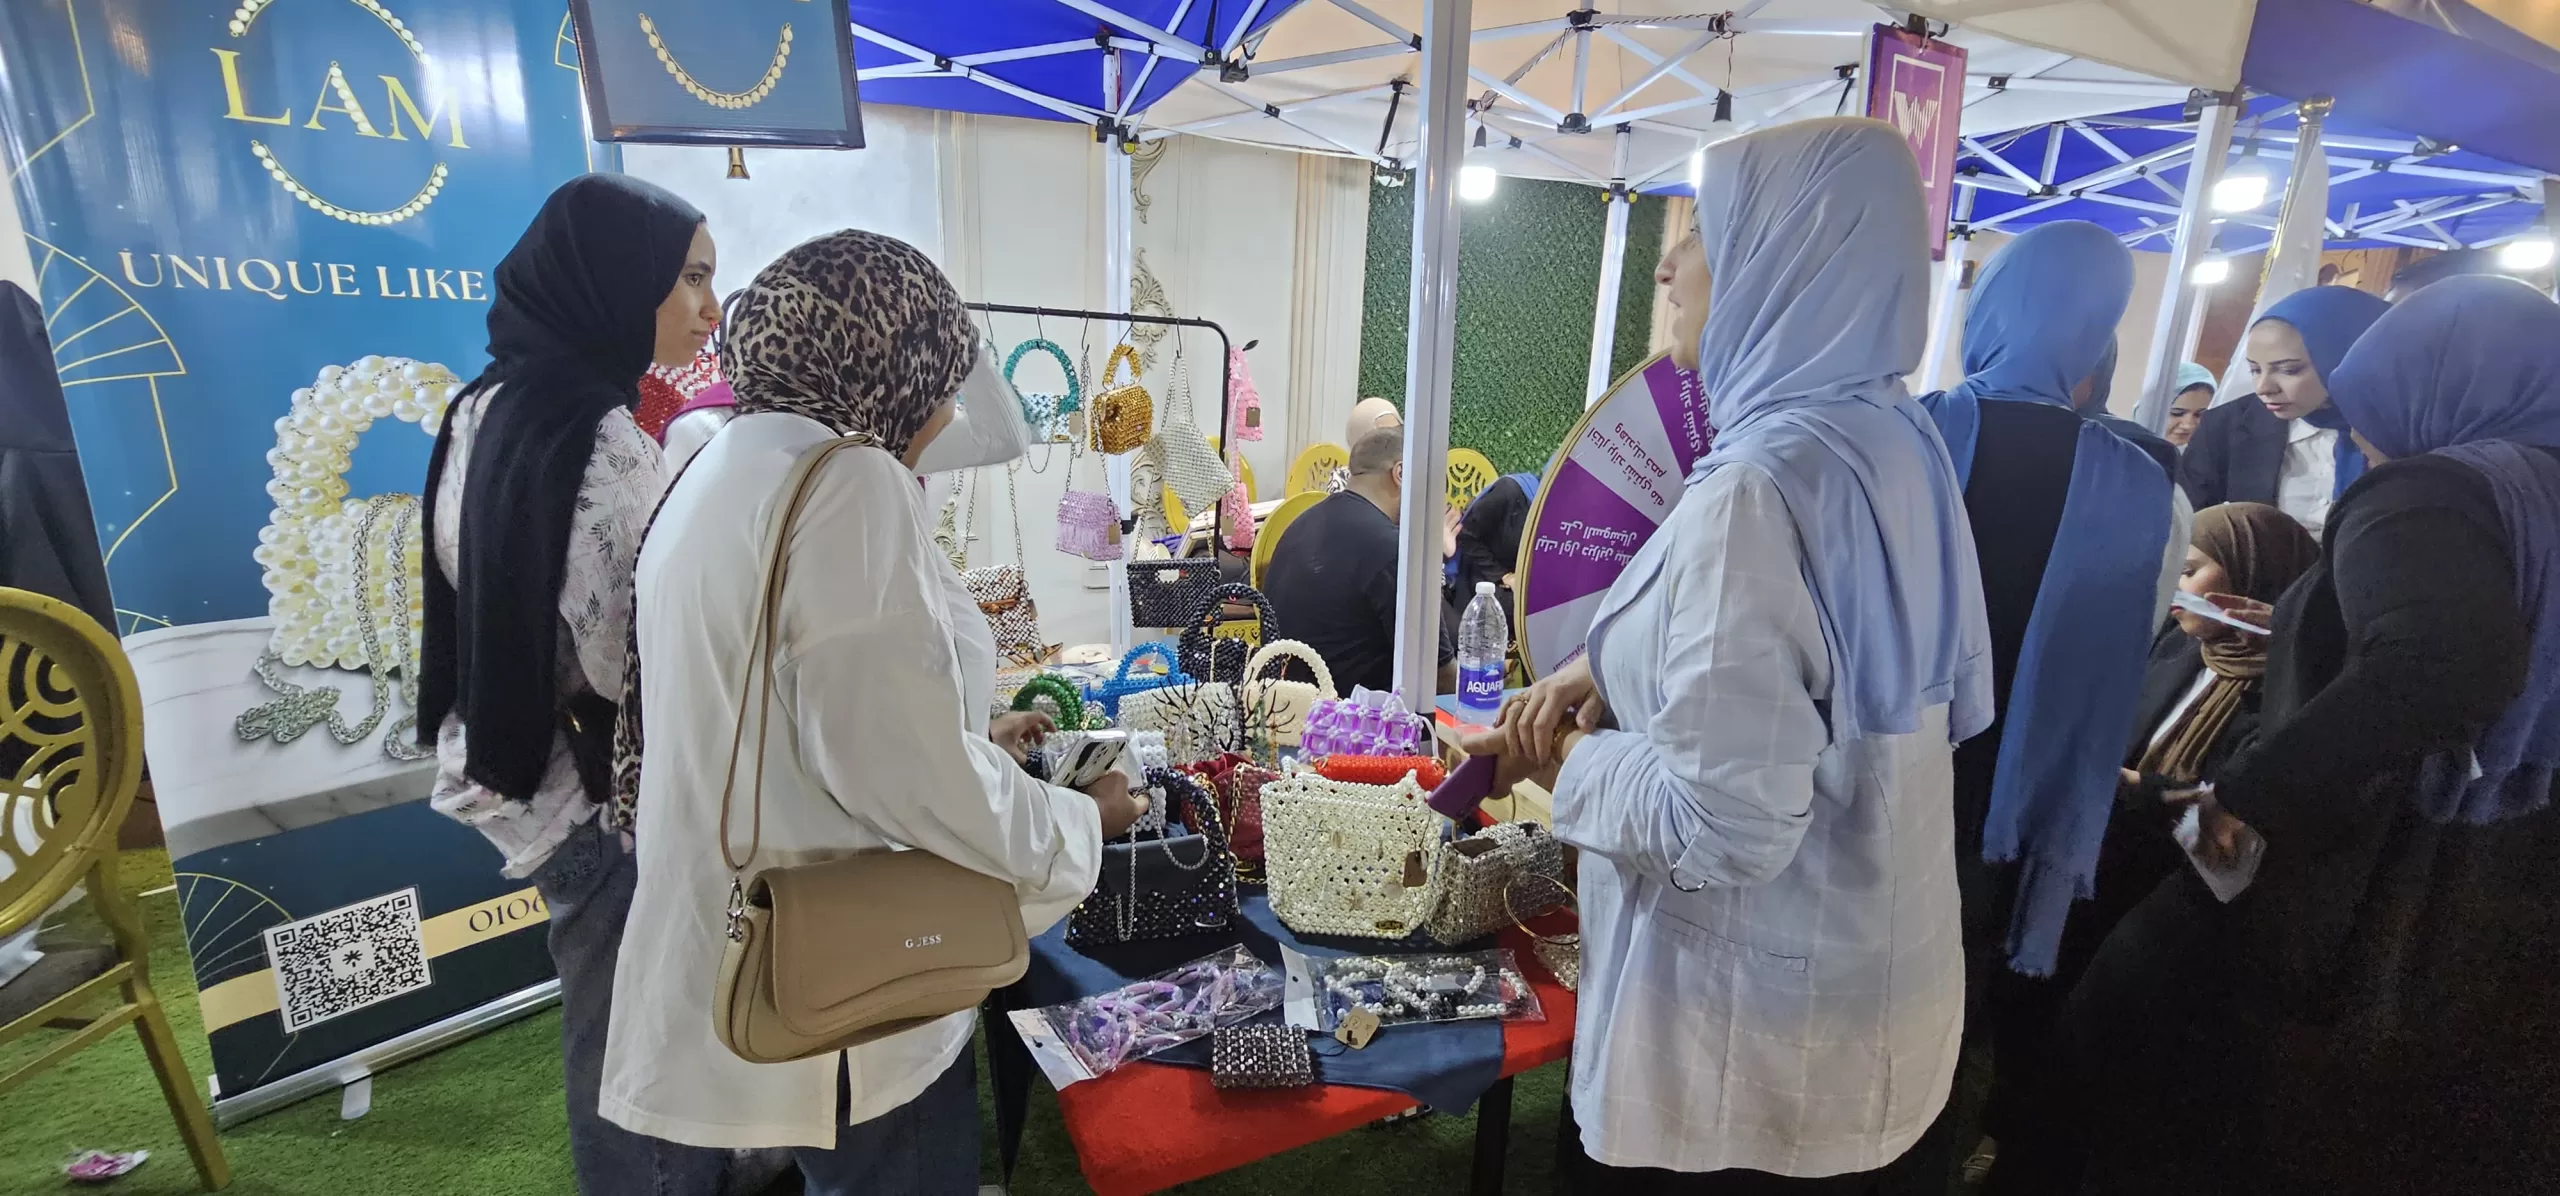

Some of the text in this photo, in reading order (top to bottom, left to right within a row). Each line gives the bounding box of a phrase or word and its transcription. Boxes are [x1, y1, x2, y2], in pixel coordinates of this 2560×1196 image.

[209, 48, 471, 149] LAM
[119, 250, 488, 301] UNIQUE LIKE
[1586, 427, 1611, 449] اختار
[1607, 442, 1627, 466] براند
[1650, 490, 1665, 506] منه
[1644, 457, 1667, 478] خصم
[1559, 520, 1638, 547] على السوشيال
[1534, 535, 1558, 552] ليك
[1558, 540, 1581, 557] اول
[1581, 544, 1614, 562] ديزاين
[1466, 680, 1503, 695] AQUAF
